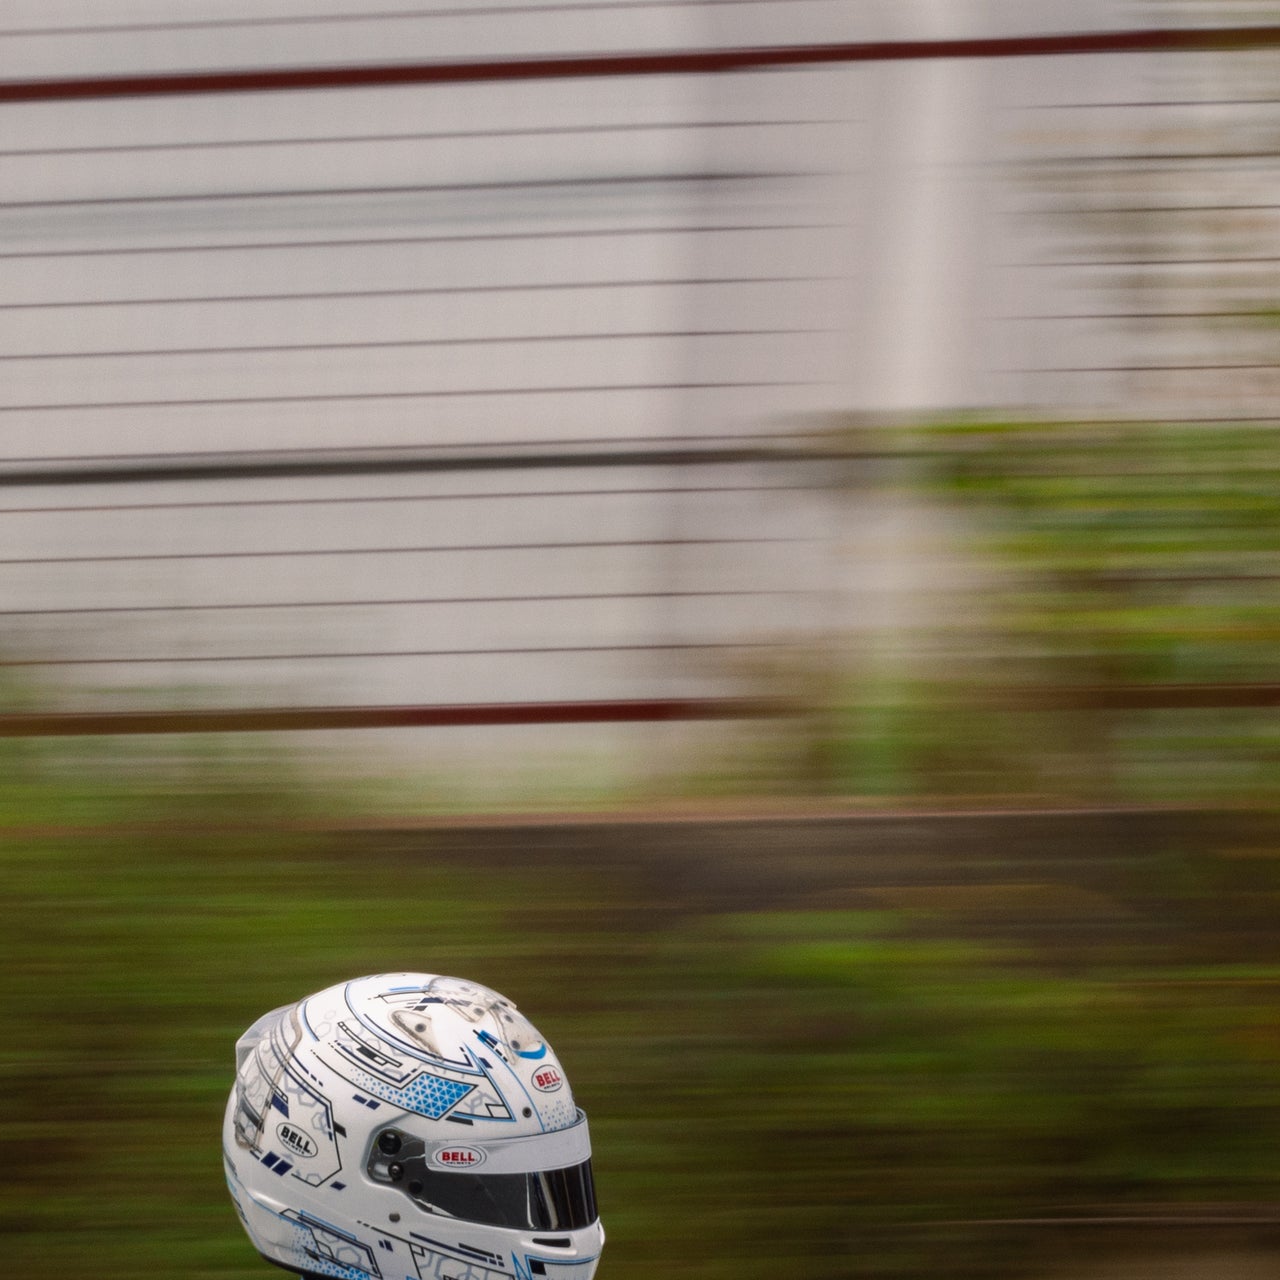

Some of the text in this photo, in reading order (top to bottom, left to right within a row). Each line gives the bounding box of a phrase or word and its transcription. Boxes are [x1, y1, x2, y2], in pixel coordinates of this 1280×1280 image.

[535, 1069, 561, 1087] BELL
[280, 1125, 313, 1156] BELL
[441, 1151, 476, 1162] BELL
